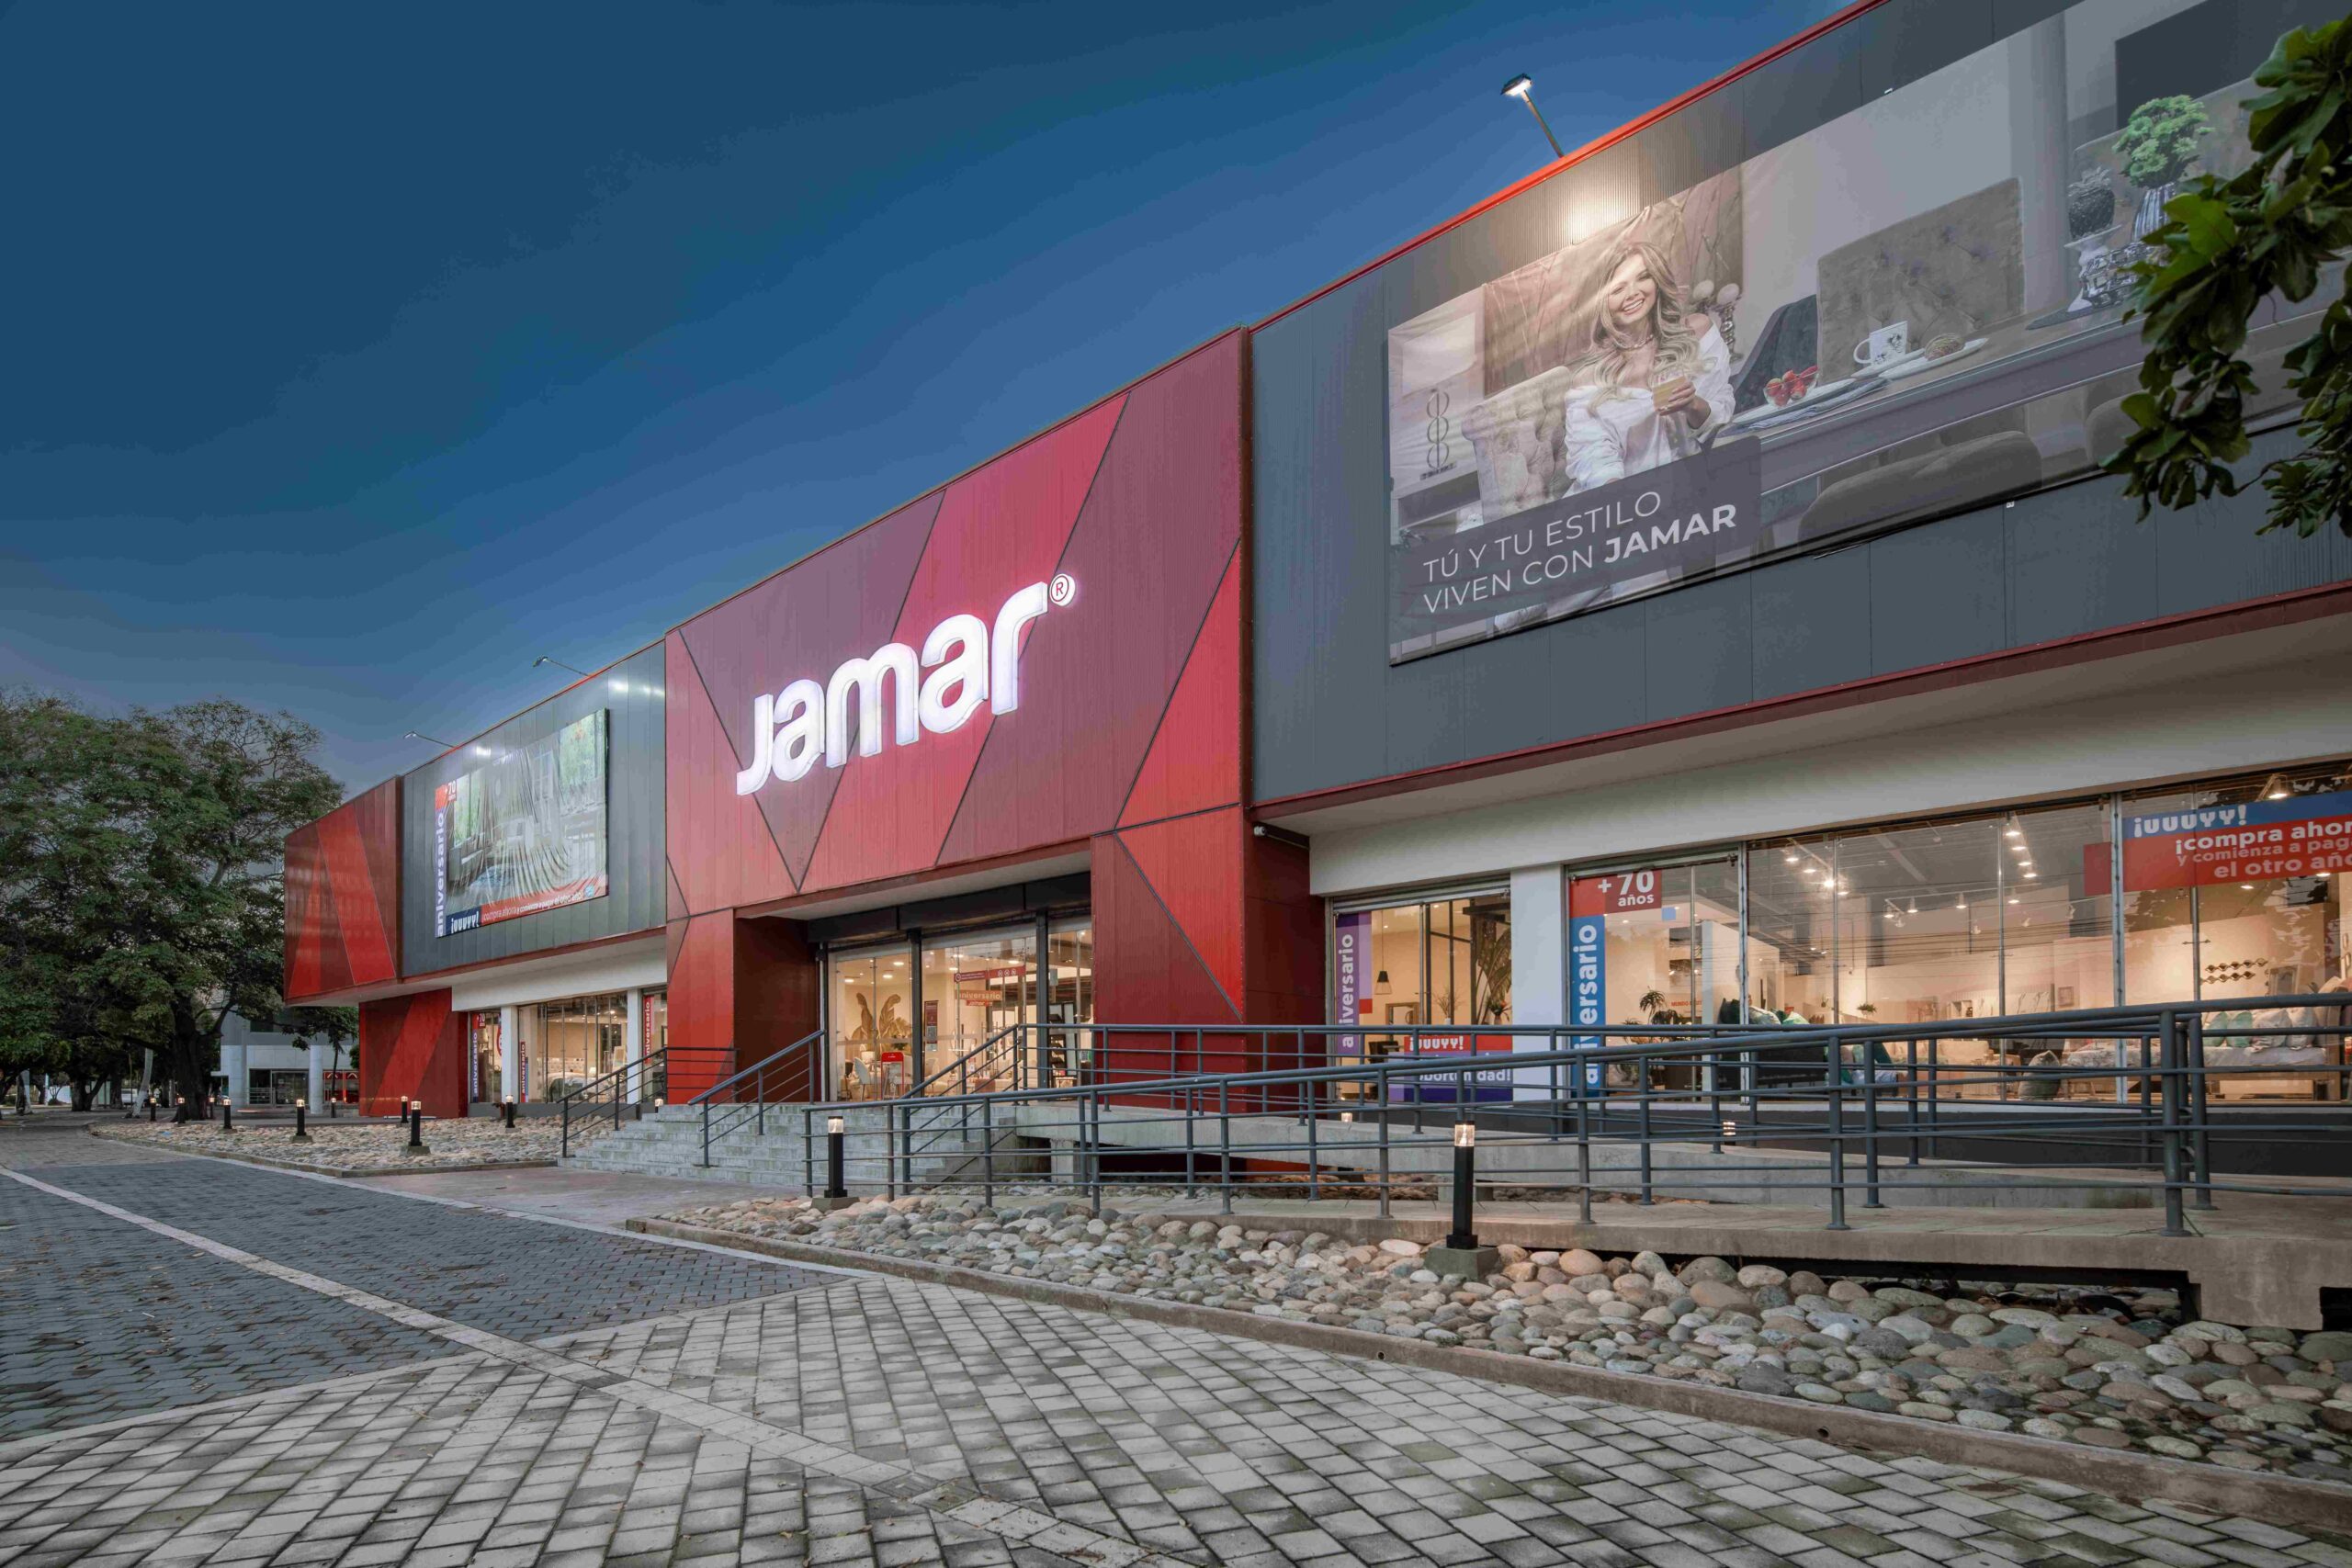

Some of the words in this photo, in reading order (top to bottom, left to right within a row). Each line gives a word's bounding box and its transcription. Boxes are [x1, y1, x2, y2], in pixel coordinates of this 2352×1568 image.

[1423, 548, 1459, 582] TÚ
[1469, 545, 1487, 569] Y
[1494, 529, 1533, 560] TU
[1545, 491, 1661, 546] ESTILO
[1423, 569, 1511, 614] VIVEN
[1522, 545, 1594, 585] CON
[1603, 502, 1736, 564] JAMAR
[736, 581, 1048, 796] jamar
[435, 813, 445, 937] aniversario
[2175, 828, 2284, 856] ¡compra
[2177, 854, 2188, 867] y
[2192, 840, 2284, 863] comienza
[2289, 842, 2301, 853] a
[2307, 836, 2352, 854] pag
[2214, 863, 2237, 879] el
[2245, 857, 2302, 875] otro
[1617, 894, 1655, 908] años
[958, 991, 1001, 1000] niversario
[1339, 934, 1354, 1048] aiversario
[1573, 925, 1599, 1085] aiersario
